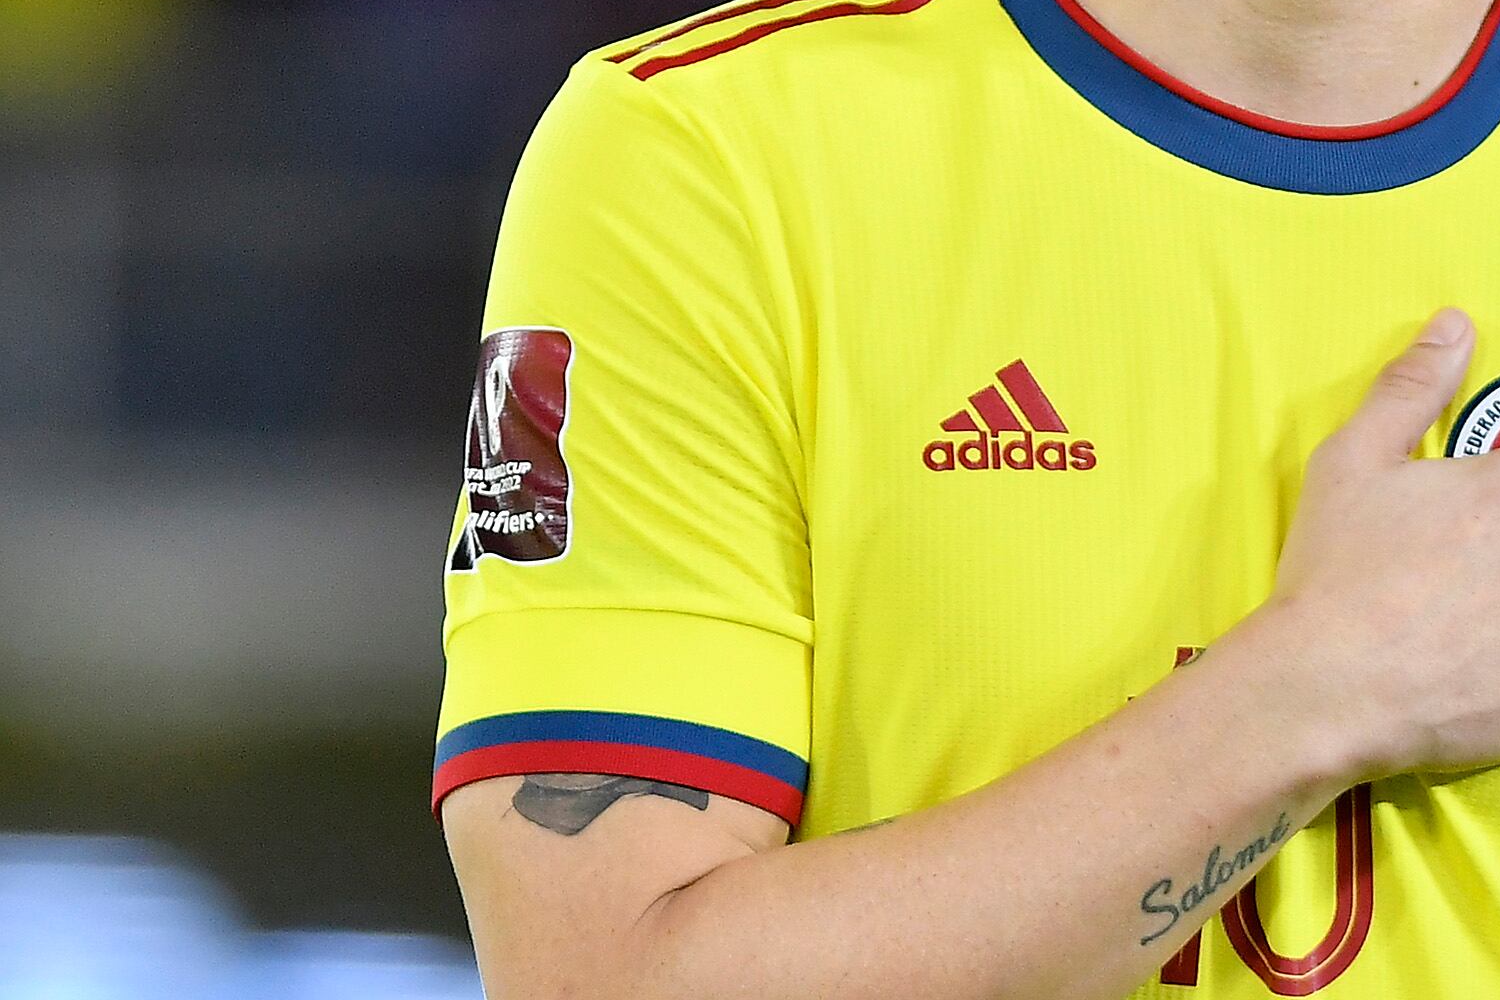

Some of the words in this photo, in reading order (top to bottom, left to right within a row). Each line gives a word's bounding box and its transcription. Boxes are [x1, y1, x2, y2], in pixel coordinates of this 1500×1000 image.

[506, 461, 532, 475] CUP
[922, 431, 1097, 471] adidas
[1140, 811, 1291, 946] Salomé
